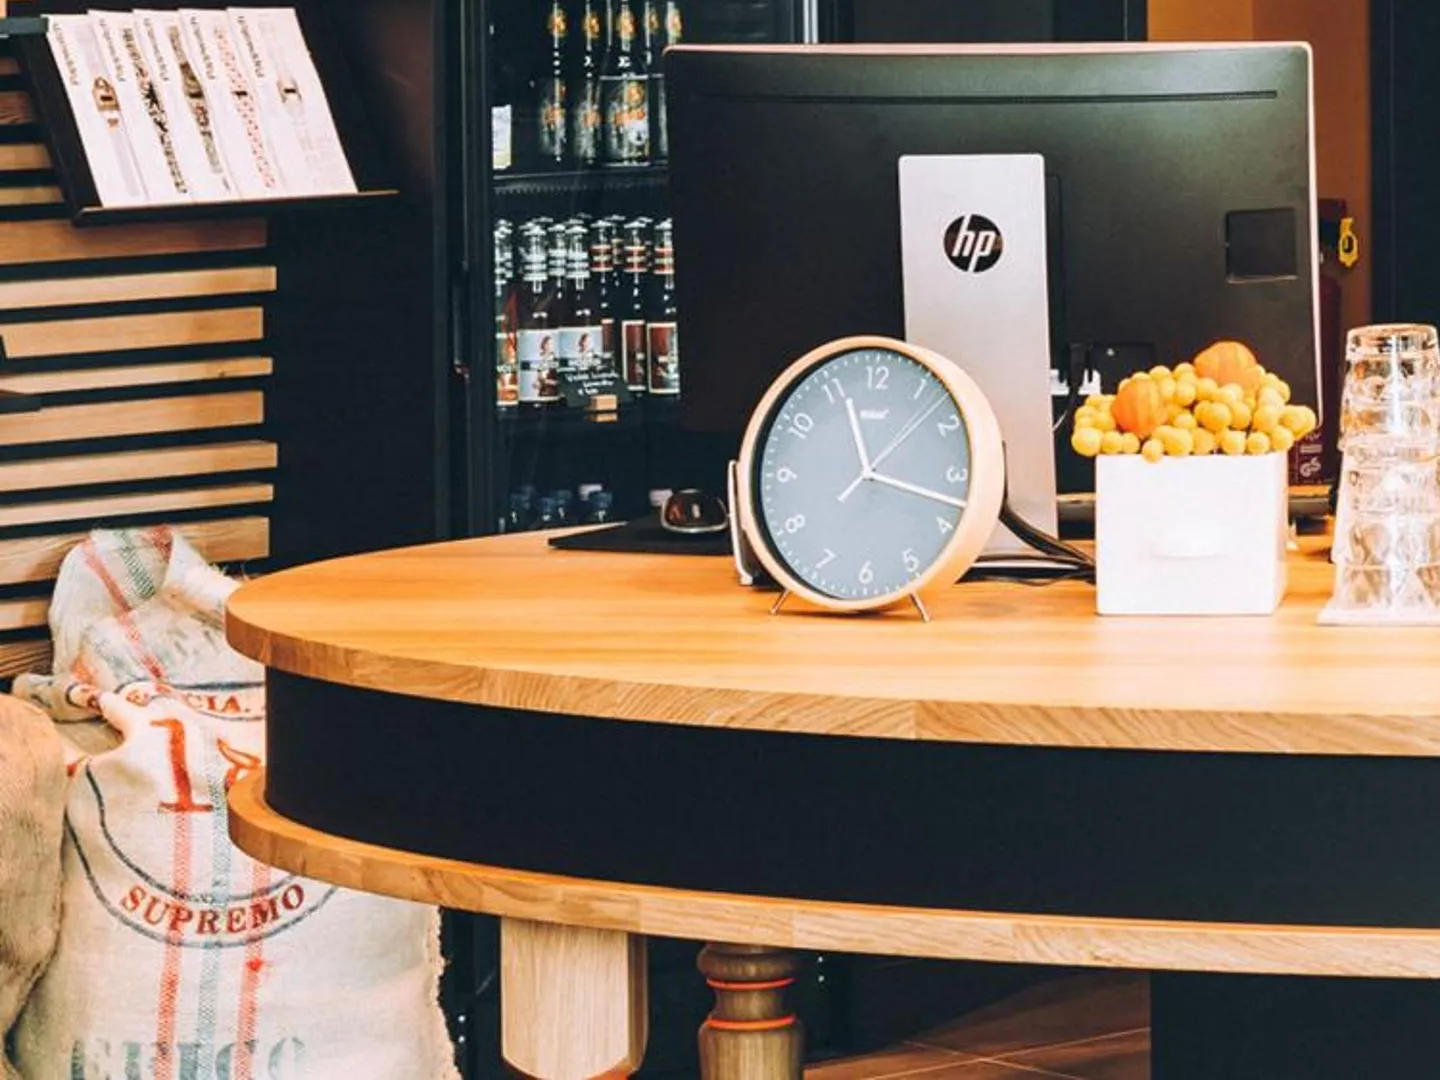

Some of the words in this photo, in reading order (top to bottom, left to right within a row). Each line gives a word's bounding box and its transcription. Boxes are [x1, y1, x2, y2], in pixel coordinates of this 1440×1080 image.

[950, 214, 997, 273] hp
[866, 366, 890, 390] 12
[913, 378, 928, 400] 1
[821, 377, 846, 404] 11
[787, 412, 814, 440] 10
[936, 415, 961, 438] 2
[776, 467, 798, 484] 9
[946, 466, 969, 484] 3
[784, 513, 806, 534] 8
[935, 515, 954, 535] 4
[814, 548, 837, 570] 7
[901, 548, 921, 573] 5
[858, 560, 875, 584] 6
[121, 883, 305, 935] SUPREMO
